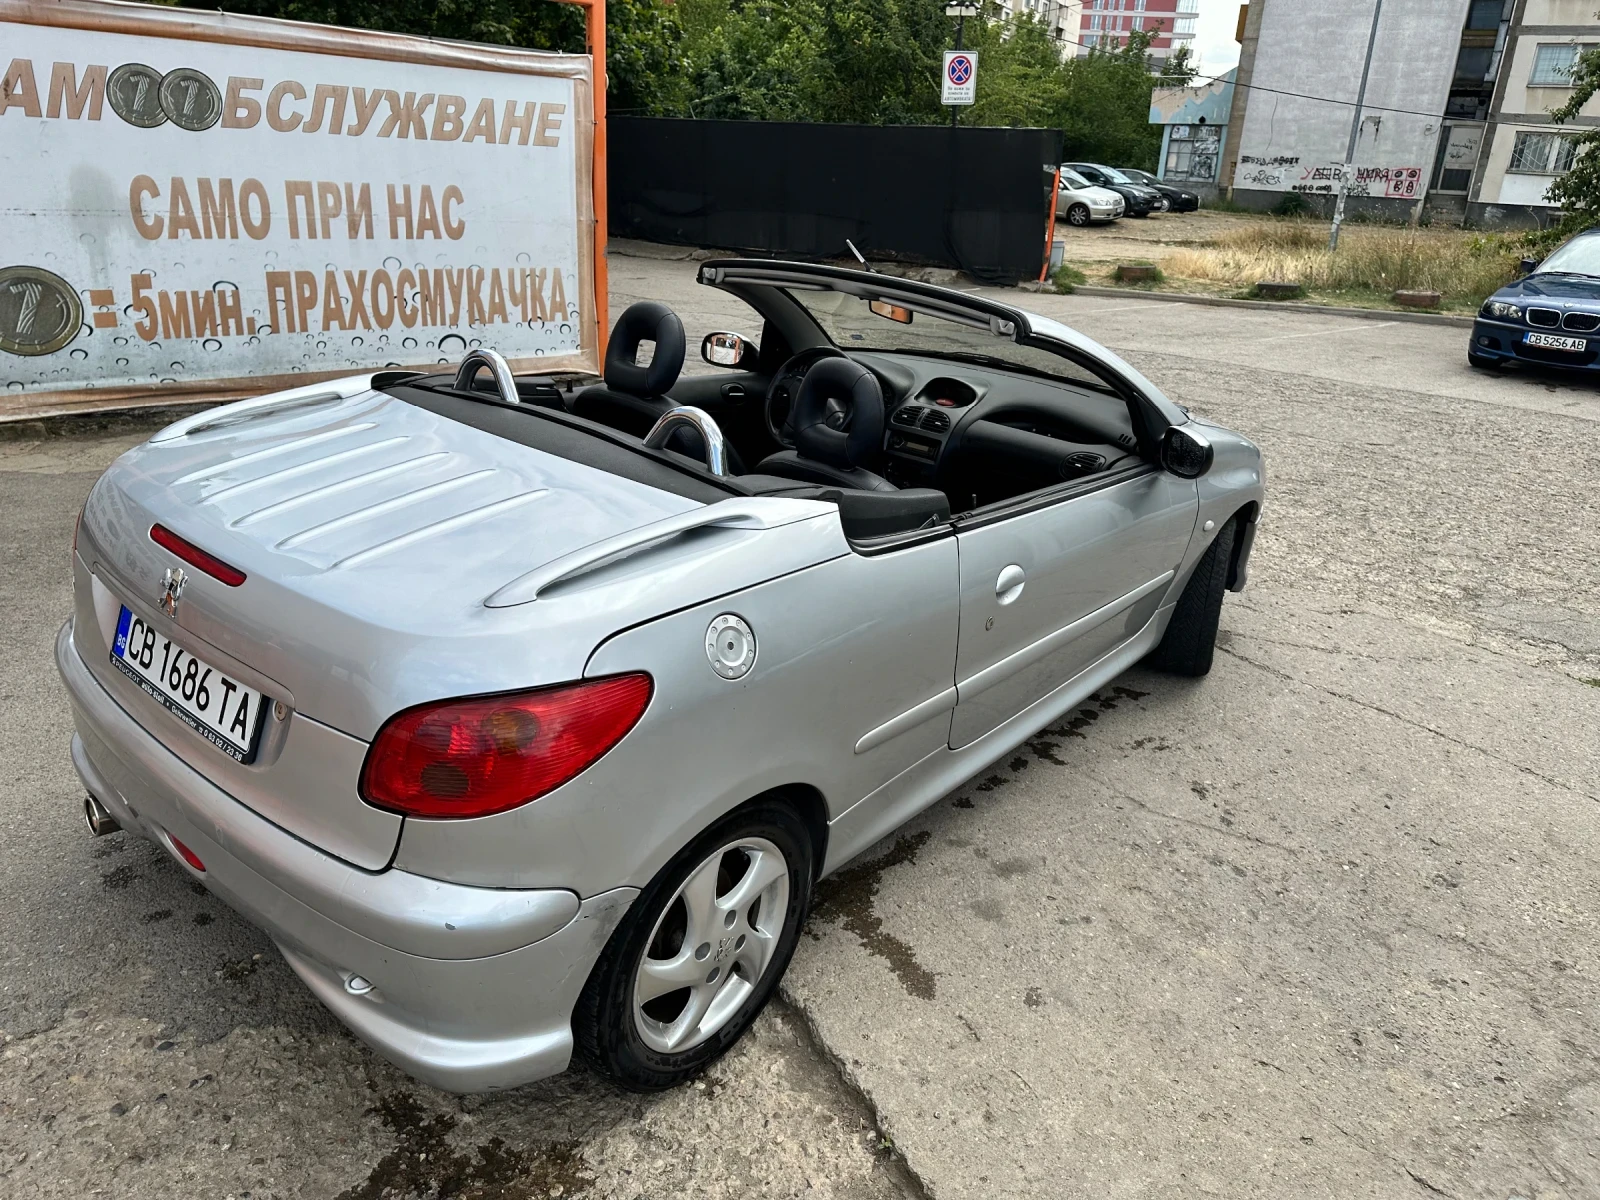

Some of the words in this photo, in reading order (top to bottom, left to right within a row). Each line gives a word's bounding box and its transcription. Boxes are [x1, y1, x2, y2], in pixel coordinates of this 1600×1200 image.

[129, 174, 271, 241] САМО
[284, 179, 374, 240] ПРИ
[386, 183, 466, 241] НАС
[265, 267, 568, 335] ПРАХОСМУКАЧКА
[1529, 334, 1542, 344] CB
[1543, 336, 1568, 348] 5256
[1570, 340, 1584, 350] AB
[117, 634, 126, 649] BG
[116, 662, 140, 683] PEUGEOT
[128, 618, 156, 670] CB
[160, 640, 212, 712] 1686
[218, 676, 250, 741] TA
